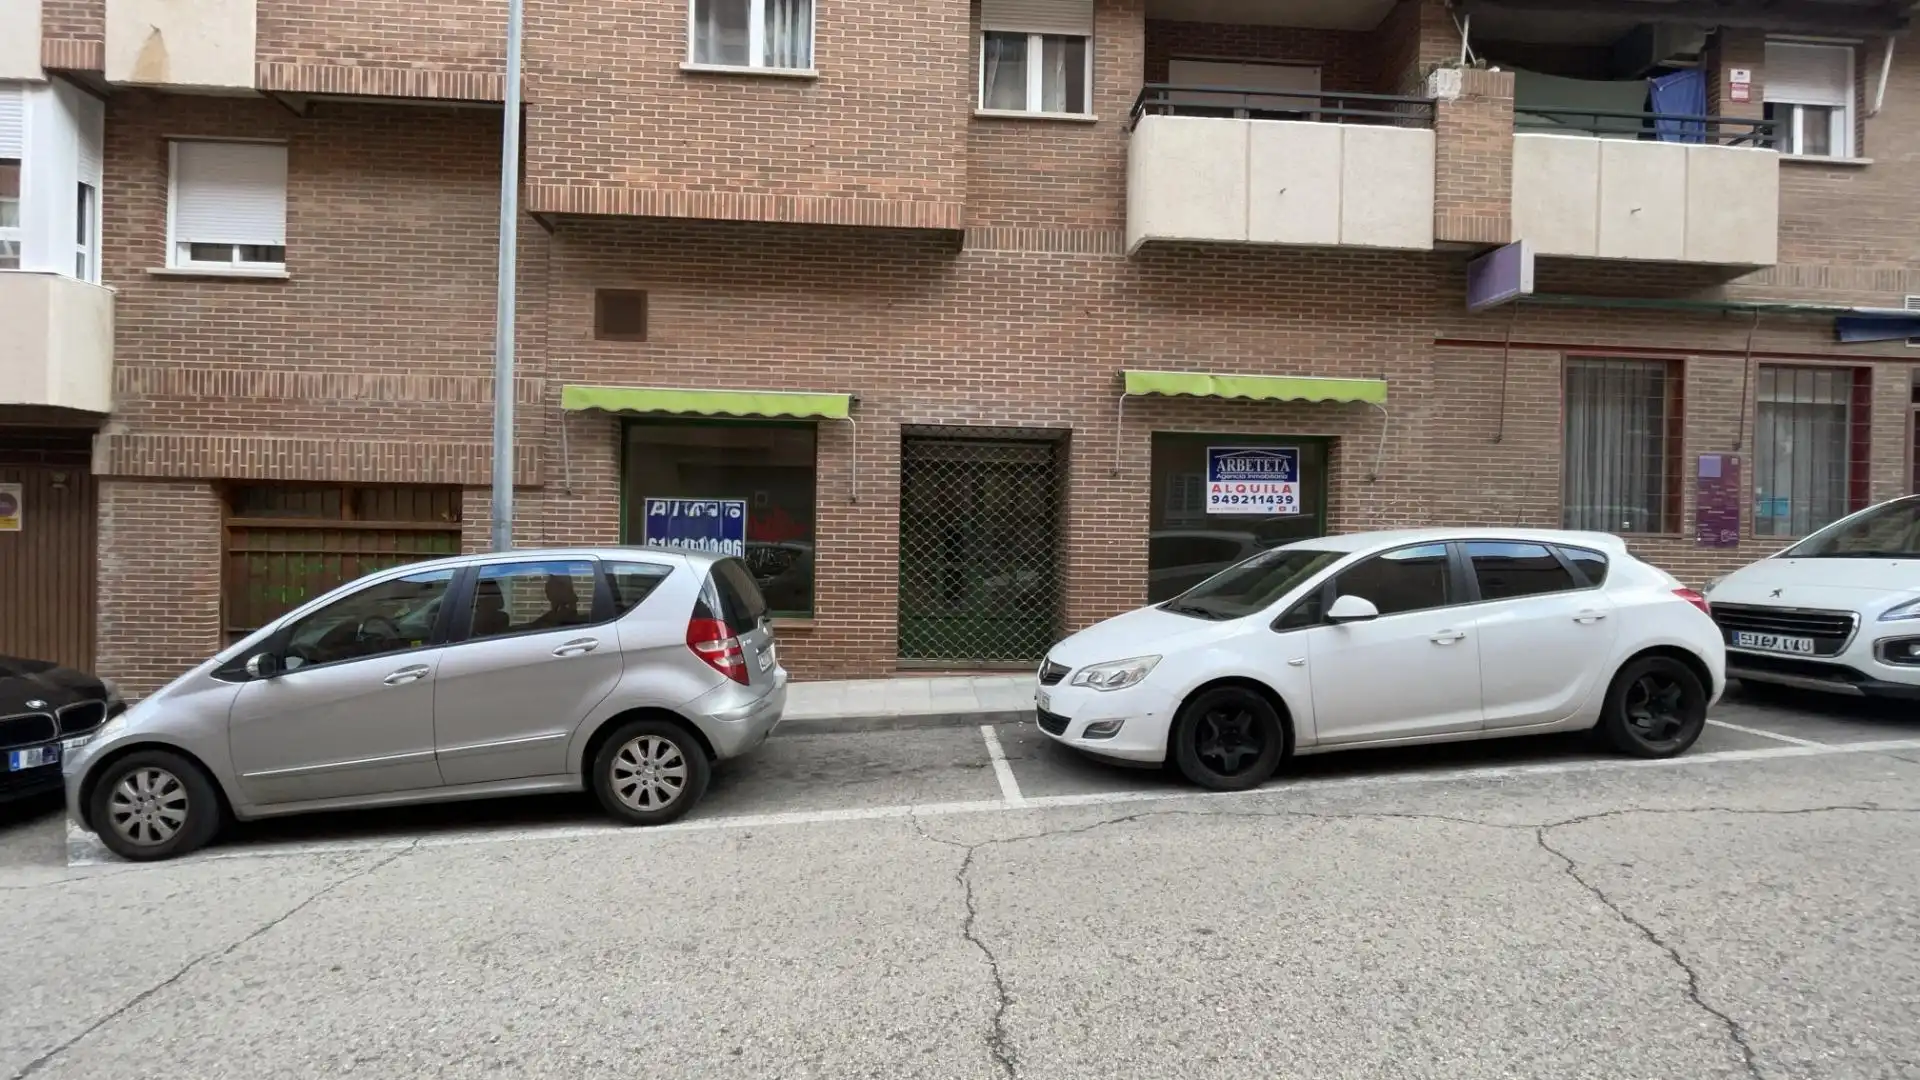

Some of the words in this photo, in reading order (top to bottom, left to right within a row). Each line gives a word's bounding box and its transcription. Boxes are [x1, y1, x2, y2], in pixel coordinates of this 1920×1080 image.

[1216, 459, 1290, 472] ARBETETA
[1212, 484, 1292, 493] ALQUILA
[1212, 495, 1294, 504] 949211439
